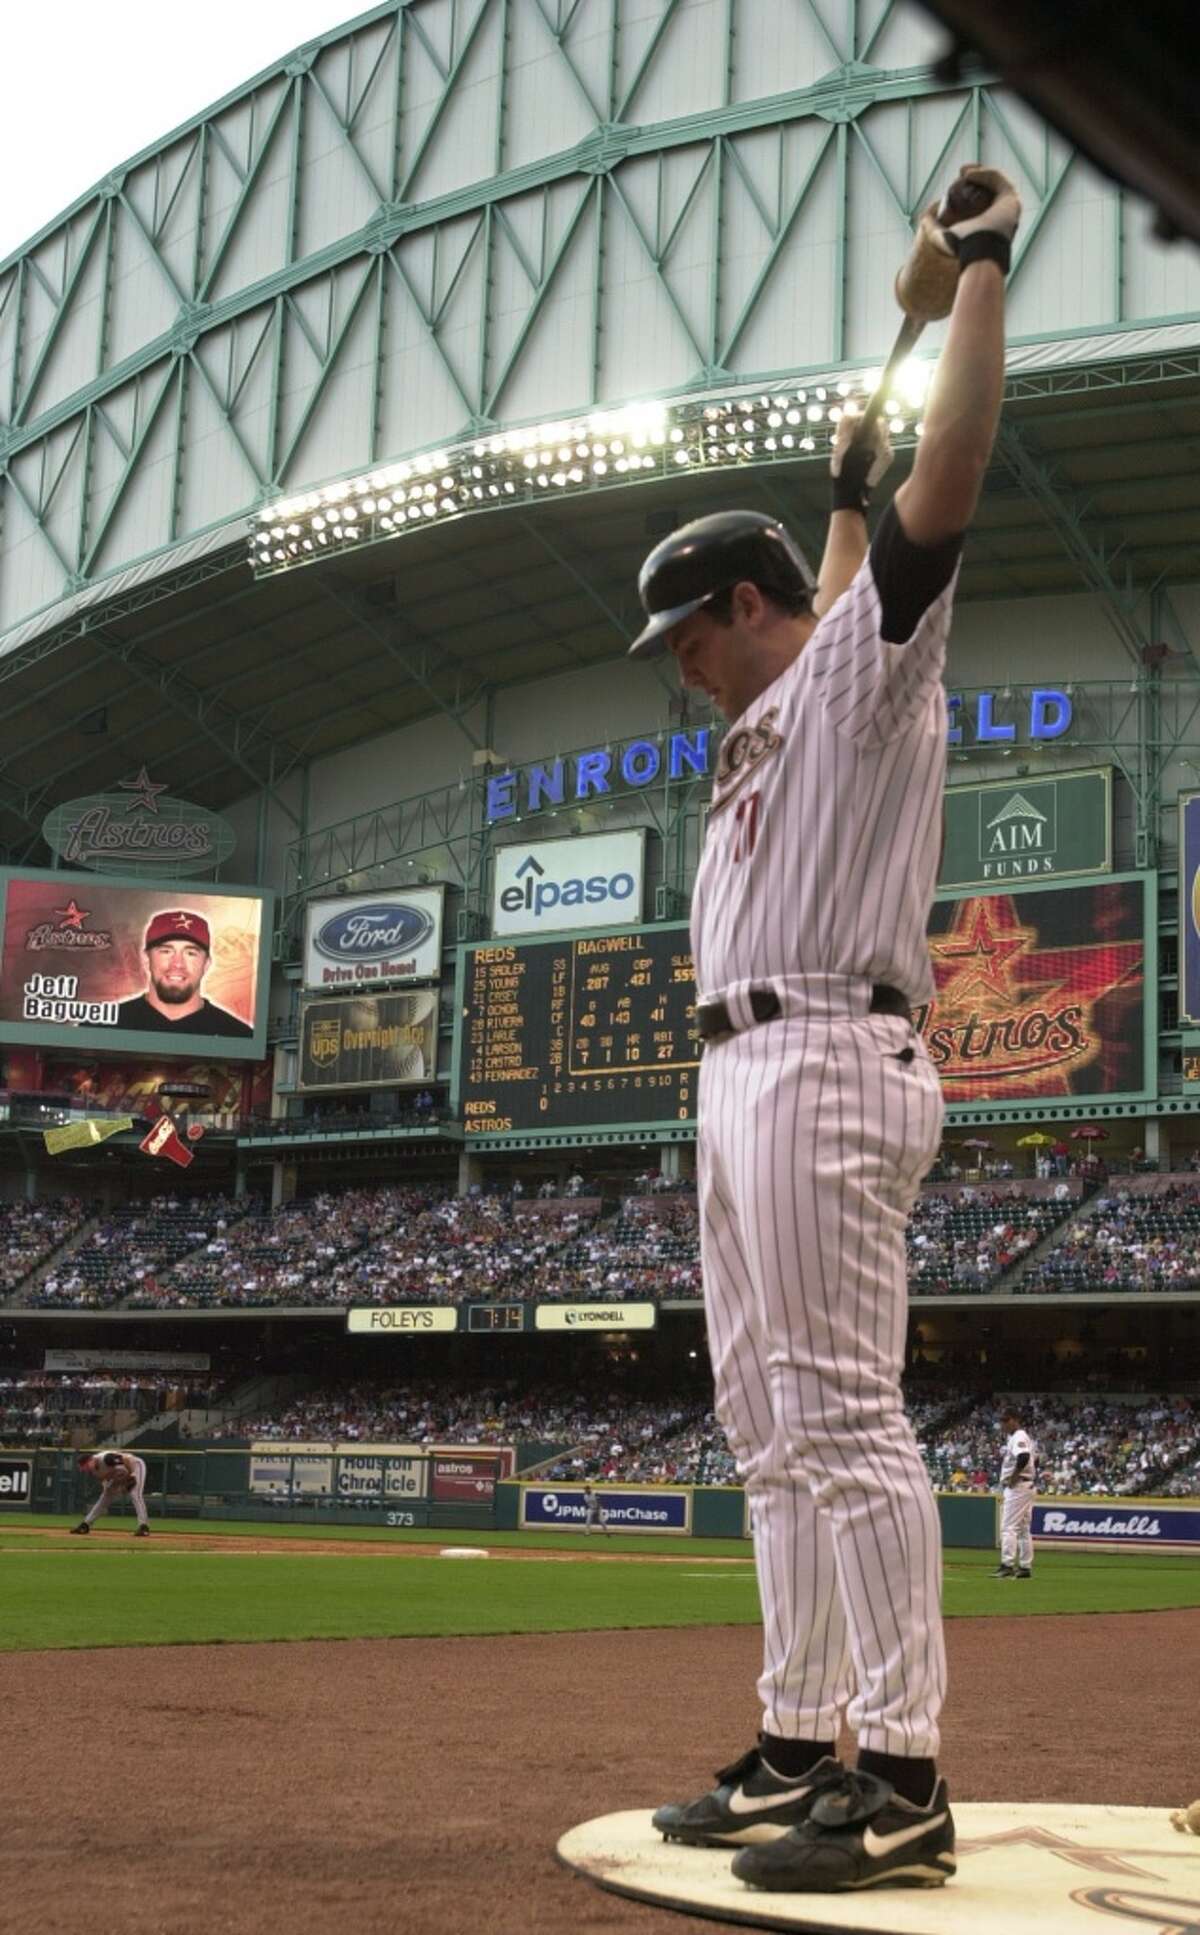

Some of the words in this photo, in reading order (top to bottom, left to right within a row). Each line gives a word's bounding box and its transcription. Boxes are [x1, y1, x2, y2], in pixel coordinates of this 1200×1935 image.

[486, 730, 710, 821] ENRON
[64, 806, 212, 861] Astros
[988, 822, 1042, 852] AIM
[340, 914, 404, 948] Ford
[475, 947, 516, 964] REDS
[578, 936, 644, 955] BAGWELL
[323, 967, 353, 983] Drive
[355, 963, 378, 980] One
[489, 977, 519, 989] YOUNG
[625, 972, 651, 987] .421
[26, 974, 77, 998] Jeff
[25, 997, 119, 1024] Bagwell
[650, 1008, 664, 1021] 41
[311, 1038, 338, 1060] ups
[627, 1048, 640, 1061] 10
[464, 1100, 496, 1114] REDS
[539, 1097, 548, 1110] 0
[680, 1088, 689, 1100] 0
[464, 1118, 512, 1132] ASTROS
[679, 1106, 687, 1119] 0
[370, 1311, 434, 1329] FOLEY'S
[578, 1310, 624, 1323] LYONDELL
[437, 1462, 473, 1475] astros
[387, 1512, 414, 1526] 373
[1043, 1511, 1161, 1536] Randalls
